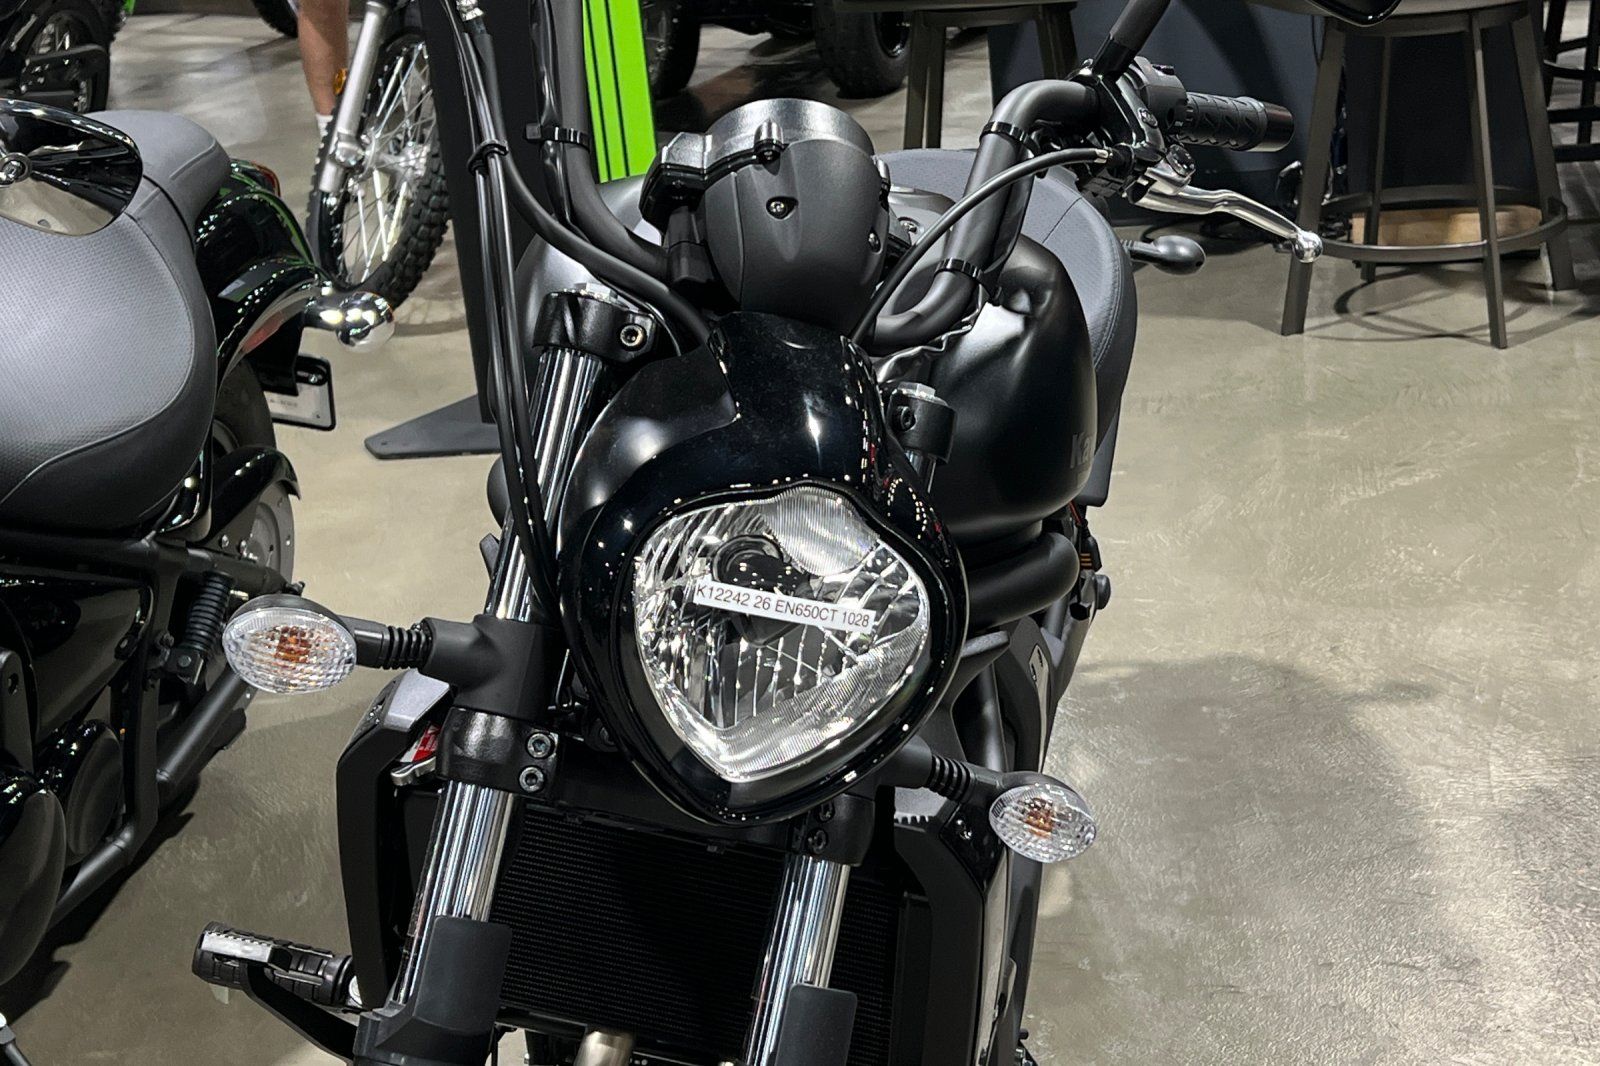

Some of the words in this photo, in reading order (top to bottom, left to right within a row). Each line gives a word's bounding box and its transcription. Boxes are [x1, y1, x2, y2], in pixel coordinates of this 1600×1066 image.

[697, 584, 750, 606] K12242
[753, 595, 771, 610] 26
[775, 600, 838, 621] EN650CT
[842, 611, 870, 627] 1028
